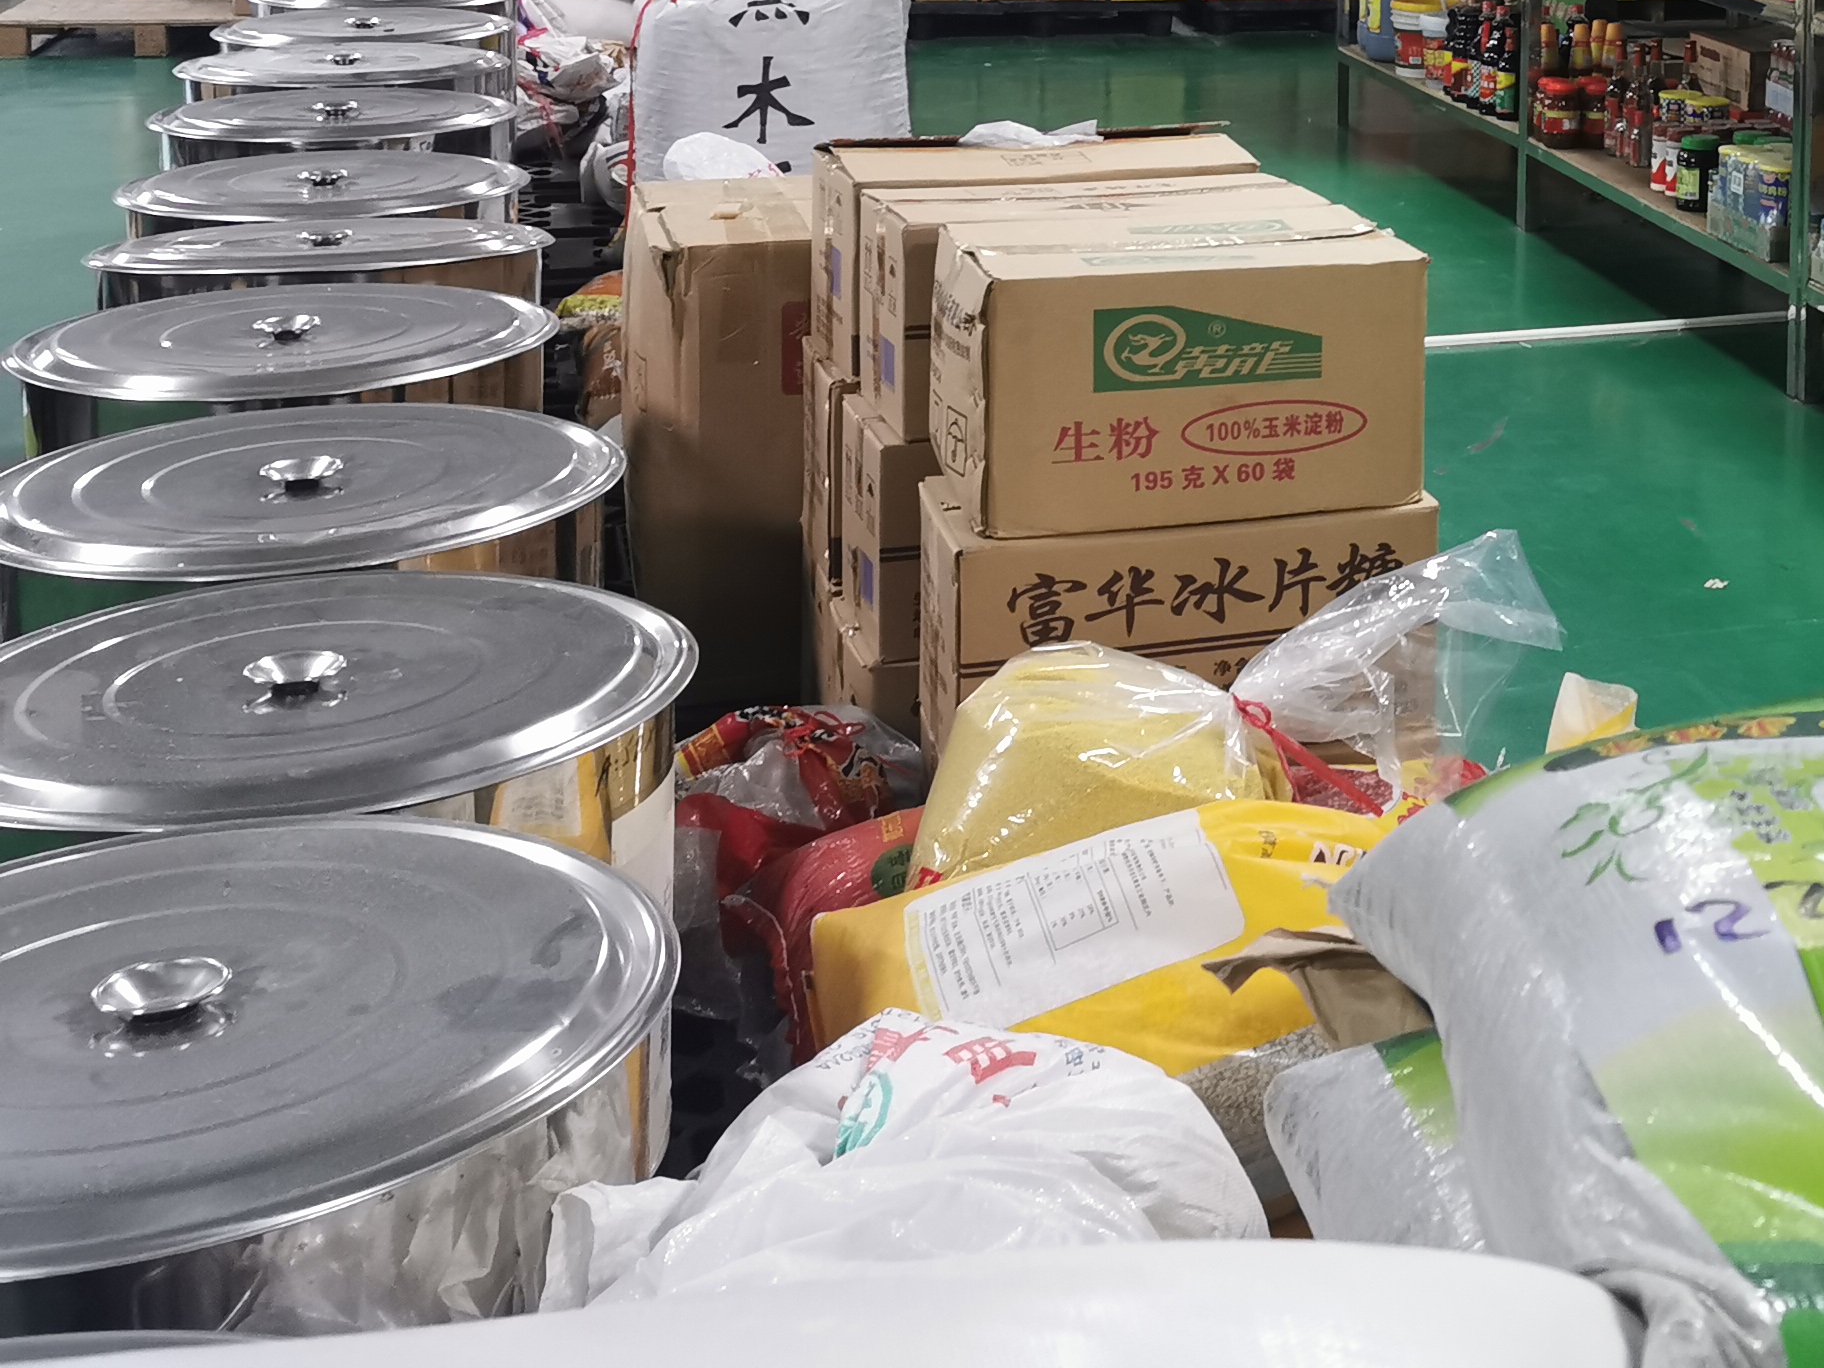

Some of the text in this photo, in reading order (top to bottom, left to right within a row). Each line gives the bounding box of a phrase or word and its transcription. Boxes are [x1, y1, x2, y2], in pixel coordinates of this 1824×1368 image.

[1051, 415, 1160, 465] 生粉
[1204, 410, 1344, 444] 100%玉米淀粉
[1130, 469, 1174, 493] 195
[1181, 465, 1205, 491] 克
[1236, 461, 1266, 483] 60
[1272, 457, 1297, 482] 袋
